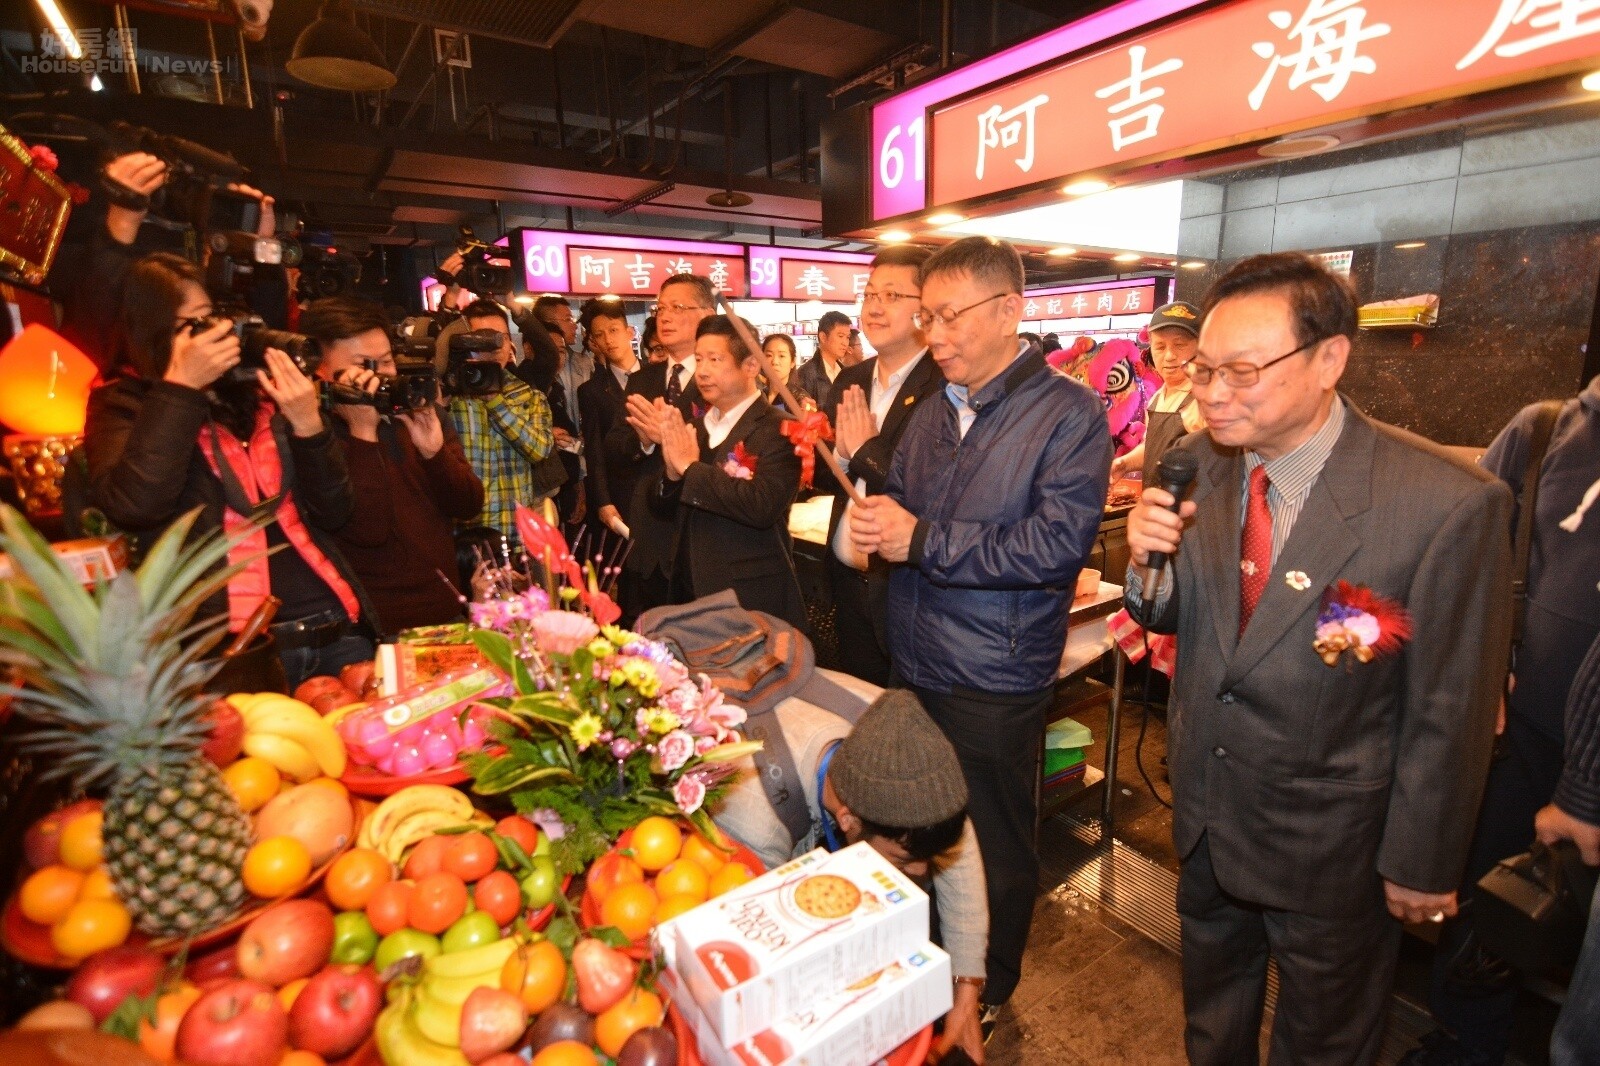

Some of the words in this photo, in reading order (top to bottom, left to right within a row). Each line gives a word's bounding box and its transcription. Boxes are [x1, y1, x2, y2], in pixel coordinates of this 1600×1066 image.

[879, 115, 925, 189] 61
[526, 244, 565, 278] 60
[751, 257, 778, 286] 59
[1023, 290, 1142, 318] 合記牛肉店
